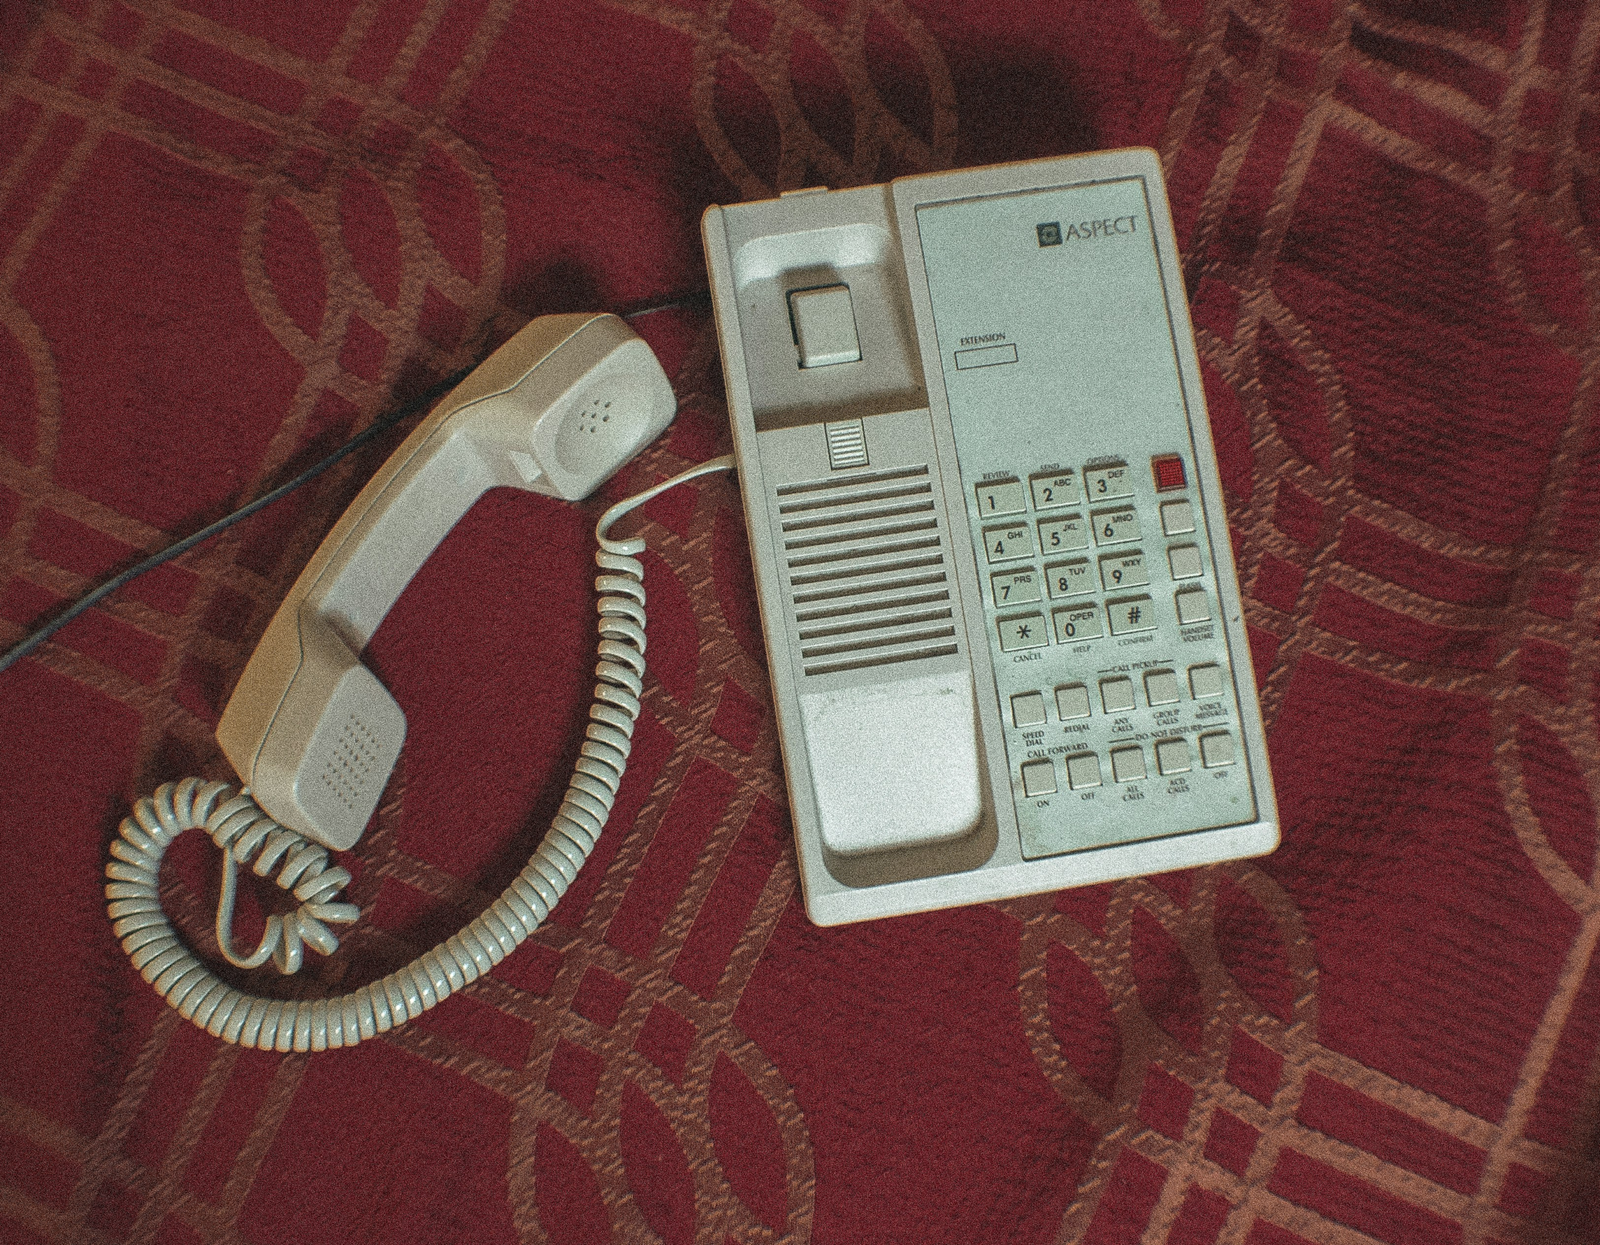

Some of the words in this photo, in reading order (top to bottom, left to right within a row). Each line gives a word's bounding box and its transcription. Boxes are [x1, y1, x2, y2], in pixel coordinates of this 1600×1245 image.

[1066, 215, 1137, 241] ASPECT
[960, 332, 1006, 346] EXTENSION
[982, 470, 1011, 480] REVIEW
[1097, 479, 1108, 493] 3
[1107, 470, 1125, 480] DEF
[1043, 487, 1053, 502] 2
[1053, 478, 1072, 488] ABC
[987, 495, 996, 510] 1
[1104, 523, 1114, 538] 6
[994, 540, 1005, 555] 4
[1006, 530, 1024, 540] GHI
[1050, 531, 1061, 546] 5
[1058, 577, 1069, 592] 8
[1068, 567, 1086, 577] TUV
[1112, 569, 1123, 584] 9
[1000, 585, 1011, 600] 7
[1013, 574, 1033, 585] PRS
[1069, 611, 1095, 622] OPER
[1127, 606, 1141, 624] #
[1064, 622, 1076, 638] 0
[1072, 644, 1092, 654] HELP
[1012, 652, 1043, 663] CANCEL
[1110, 664, 1131, 673] CALL
[1156, 717, 1179, 727] CALLS
[1063, 723, 1091, 734] REDIAL
[1111, 723, 1134, 733] CALLS
[1021, 730, 1045, 740] SPEED
[1134, 732, 1149, 741] DO
[1150, 729, 1168, 739] NOT
[1025, 738, 1044, 747] DIAL
[1027, 749, 1047, 759] CALL
[1047, 742, 1089, 755] FORWARD
[1125, 785, 1139, 793] ALL
[1166, 784, 1190, 795] CALLS
[1081, 792, 1095, 801] OFF
[1122, 791, 1145, 802] CALLS
[1037, 800, 1050, 808] ON
